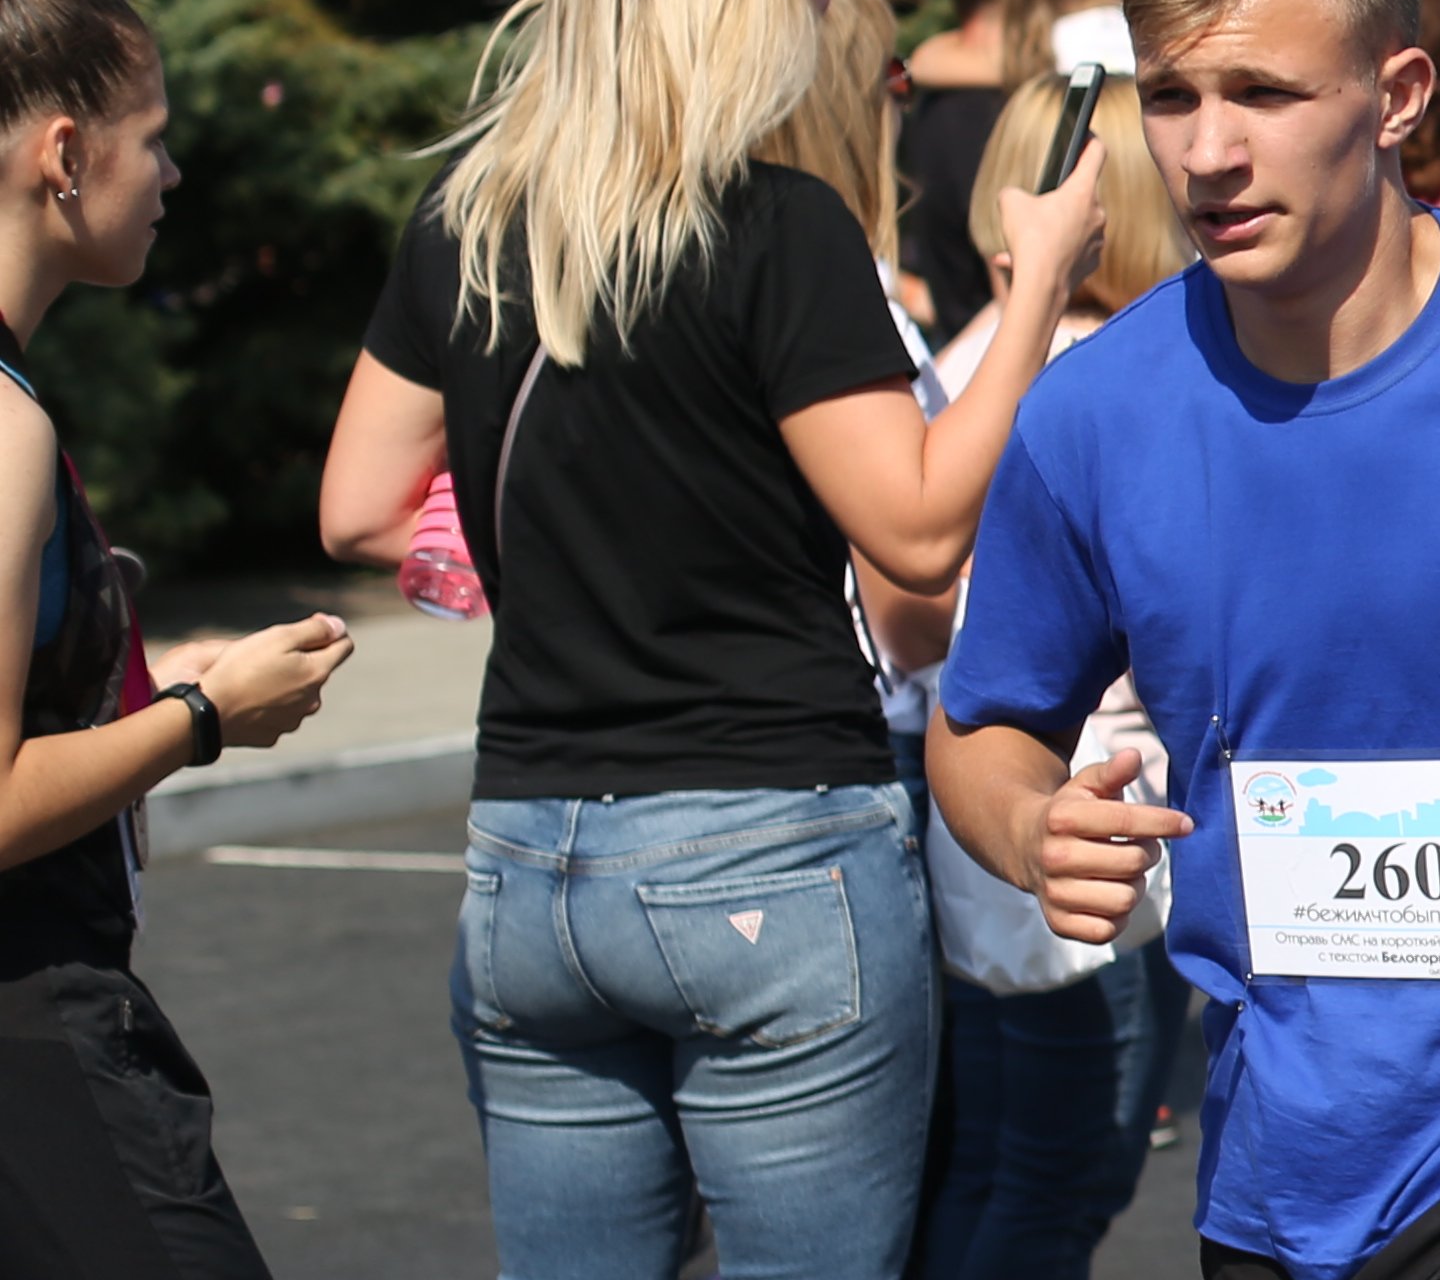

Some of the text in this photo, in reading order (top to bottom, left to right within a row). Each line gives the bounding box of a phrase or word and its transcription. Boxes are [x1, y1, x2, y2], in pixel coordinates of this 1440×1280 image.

[1274, 931, 1328, 946] Отправь
[1330, 932, 1359, 946] СМС
[1362, 936, 1378, 946] на
[1380, 935, 1440, 948] короткий
[1329, 952, 1378, 962] текстом
